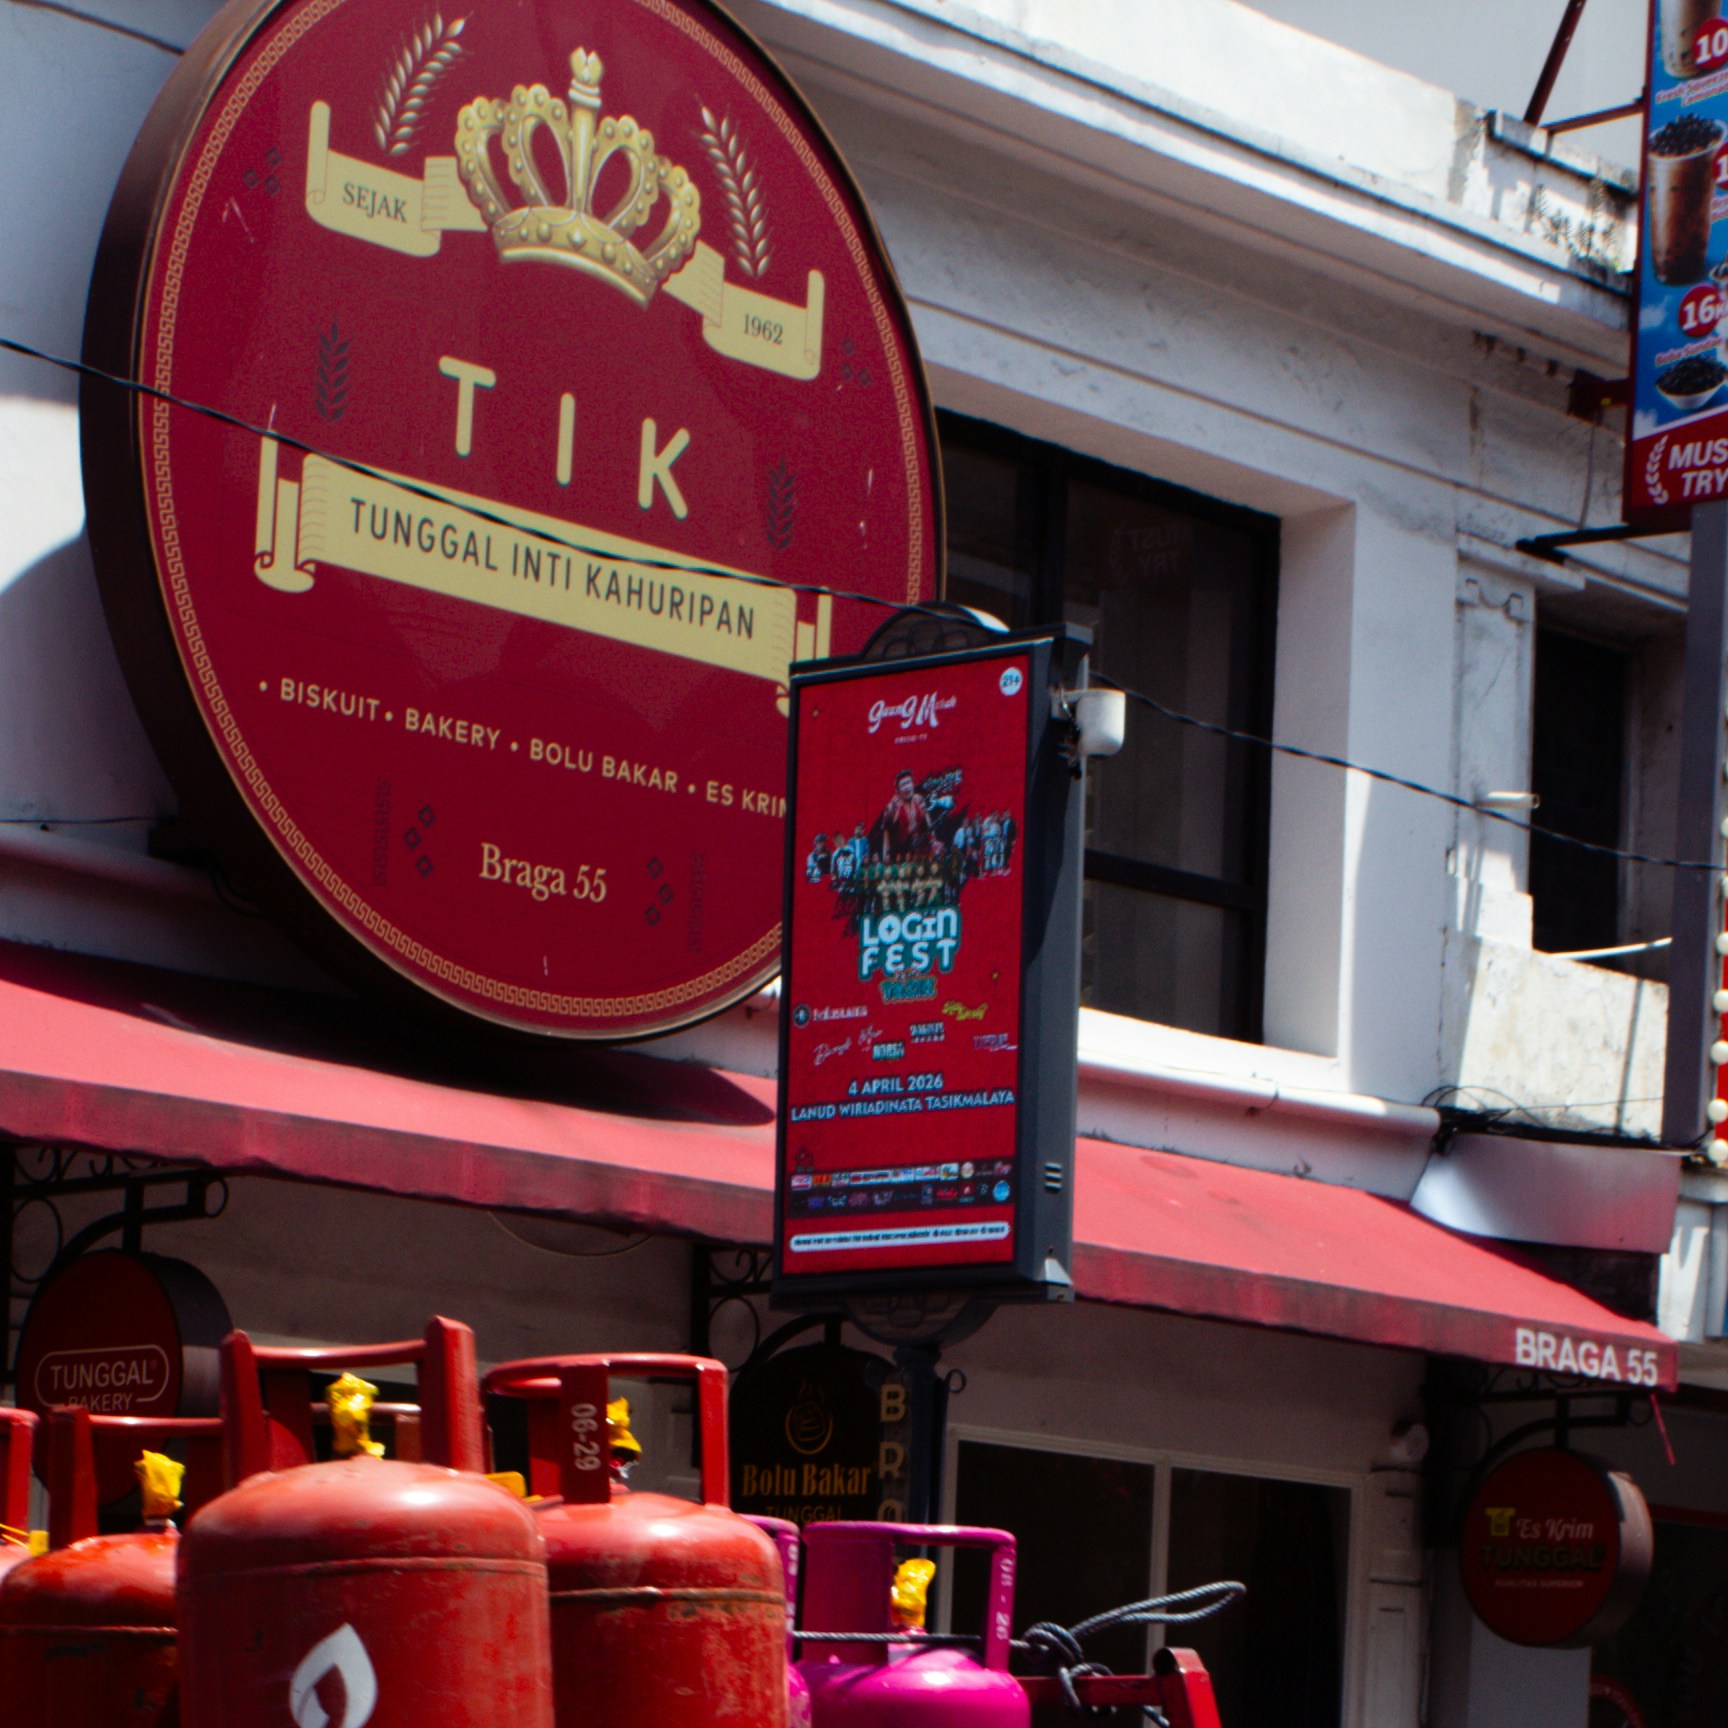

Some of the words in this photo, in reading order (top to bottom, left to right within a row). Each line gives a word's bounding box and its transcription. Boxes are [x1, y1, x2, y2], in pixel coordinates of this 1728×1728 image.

[342, 180, 408, 225] SEJAK
[741, 313, 785, 345] 1962
[350, 497, 499, 572] TUNGGAL
[511, 542, 572, 591] INTI
[586, 562, 754, 640] KAHURIPAN
[279, 677, 381, 721] BISKUIT
[405, 707, 502, 750] BAKERY
[529, 738, 594, 772] BOLU
[601, 755, 679, 793] BAKAR
[705, 780, 734, 806] ES
[478, 842, 568, 901] Braga
[572, 864, 608, 903] 55
[862, 938, 957, 978] FEST
[847, 1079, 859, 1096] 4
[861, 1076, 903, 1095] APRIL
[907, 1073, 944, 1091] 2026
[791, 1103, 836, 1122] LANUD
[838, 1098, 923, 1119] WIRIADINATA
[924, 1089, 1015, 1112] TASIKMALAYA
[1515, 1327, 1622, 1380] BRAGA
[1626, 1348, 1659, 1387] 55
[51, 1360, 154, 1392] TUNGGAL
[68, 1392, 133, 1413] BAKERY
[572, 1403, 601, 1472] 06-29
[742, 1464, 797, 1497] Bolu
[802, 1463, 872, 1496] Bakar
[1516, 1517, 1542, 1540] Es
[1545, 1517, 1595, 1543] Krim
[1481, 1544, 1605, 1573] TUNGGAL
